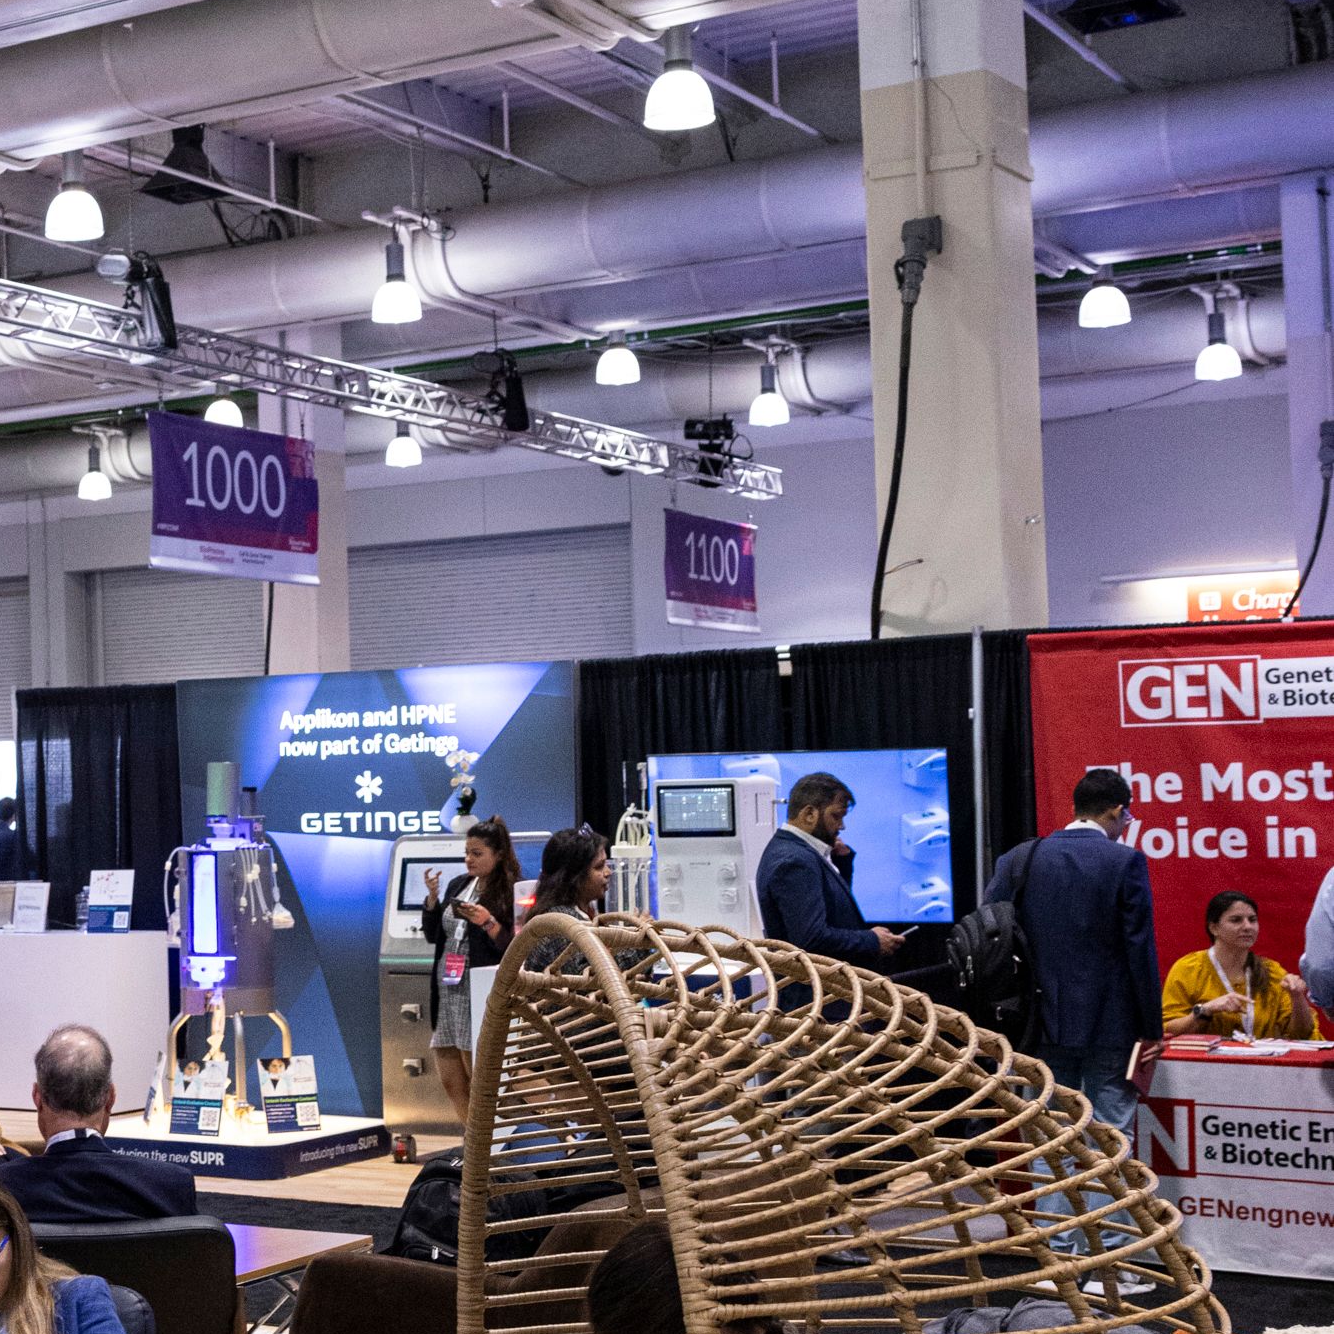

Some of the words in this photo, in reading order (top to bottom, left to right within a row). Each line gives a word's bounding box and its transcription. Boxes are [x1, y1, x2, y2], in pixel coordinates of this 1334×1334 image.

[182, 441, 286, 518] 1000
[685, 531, 740, 586] 1100
[1265, 665, 1334, 685] Genet
[1126, 662, 1257, 720] GEN
[1267, 693, 1279, 706] &
[279, 707, 360, 734] Applikon
[362, 705, 398, 727] and
[401, 703, 457, 725] HPNE
[279, 741, 319, 757] now
[320, 735, 360, 760] part
[362, 733, 383, 754] of
[384, 731, 459, 757] Getinge
[1086, 761, 1183, 803] he
[1199, 761, 1334, 802] Most
[300, 810, 442, 833] GETINGE
[1265, 815, 1317, 859] in
[357, 1134, 379, 1151] SUPR
[1201, 1114, 1302, 1142] Genetic
[1308, 1120, 1334, 1143] En
[150, 1149, 168, 1162] the
[168, 1153, 189, 1163] new
[189, 1150, 225, 1167] SUPR
[1204, 1145, 1218, 1160] &
[1221, 1142, 1334, 1171] Biotechn
[1177, 1195, 1334, 1229] GENengnew
